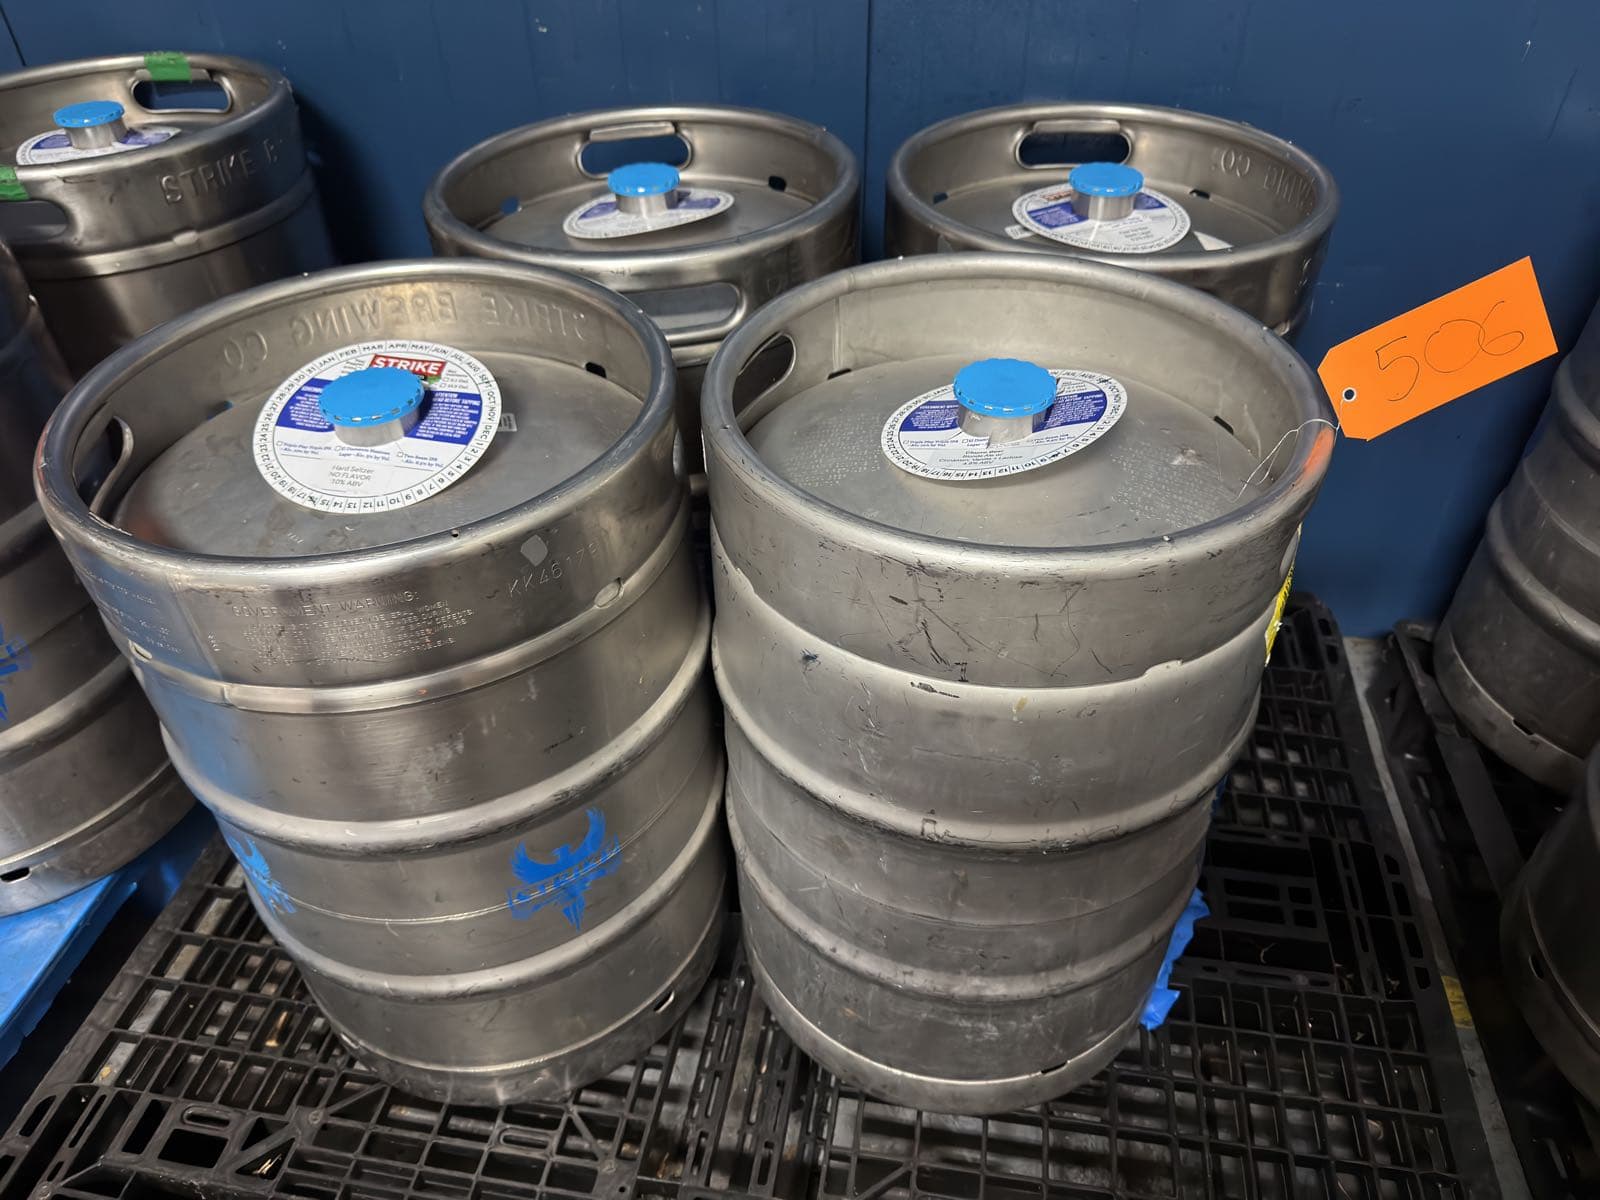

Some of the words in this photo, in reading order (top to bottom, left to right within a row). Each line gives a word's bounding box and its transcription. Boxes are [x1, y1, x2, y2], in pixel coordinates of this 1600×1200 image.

[158, 148, 256, 206] STRIKE
[340, 348, 357, 358] FEB
[362, 344, 383, 352] MAR
[412, 344, 430, 352] MAY
[432, 346, 448, 354] JUN
[1374, 300, 1524, 402] 506
[318, 356, 335, 367] JAN
[370, 356, 442, 376] STRIKE
[466, 361, 481, 372] AUG
[488, 390, 496, 406] OCT
[488, 406, 496, 422] NOV
[480, 424, 492, 440] DEC
[332, 464, 350, 472] Hard
[350, 466, 375, 474] Seltzer
[341, 472, 371, 481] FLAVOR
[232, 602, 332, 618] GOVERNMENT
